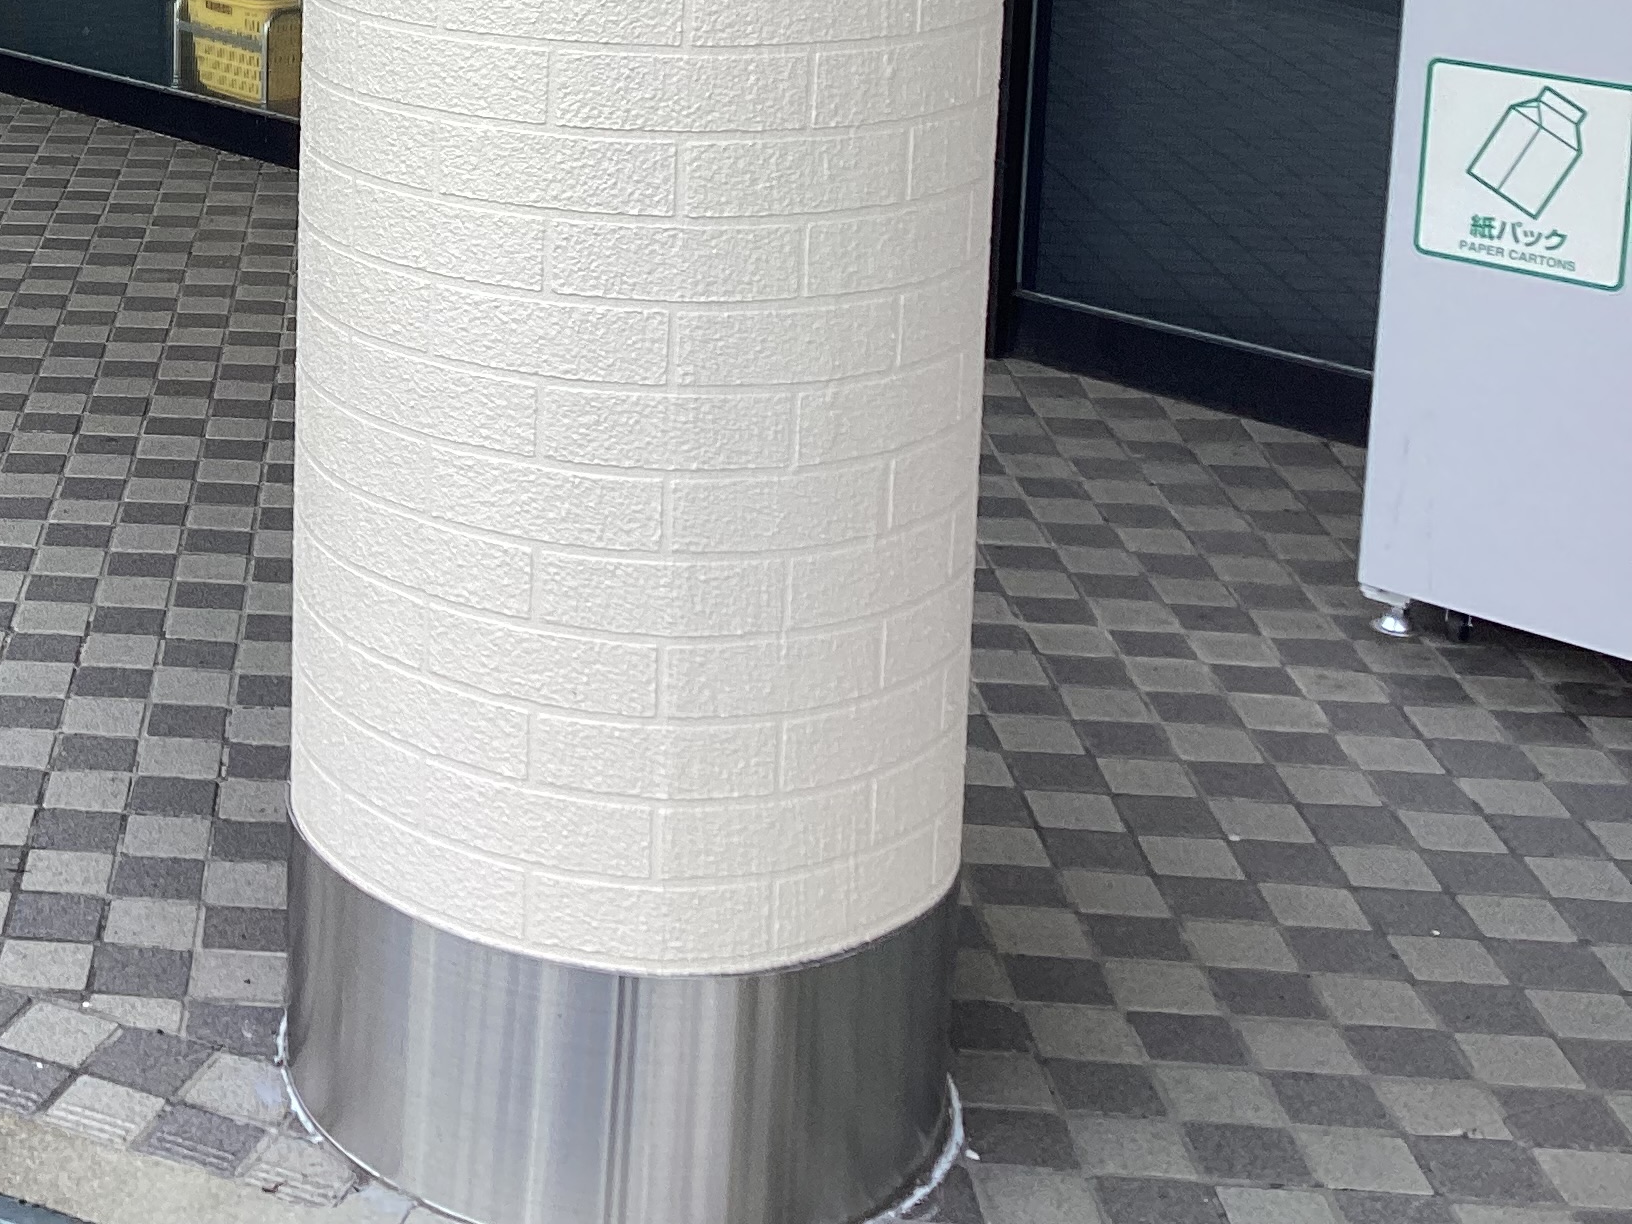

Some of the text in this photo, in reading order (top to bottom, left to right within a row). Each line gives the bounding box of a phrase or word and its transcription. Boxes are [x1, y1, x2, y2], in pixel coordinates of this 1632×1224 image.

[1470, 214, 1568, 251] 紙パック
[1459, 239, 1576, 272] PAPER CARTONS
